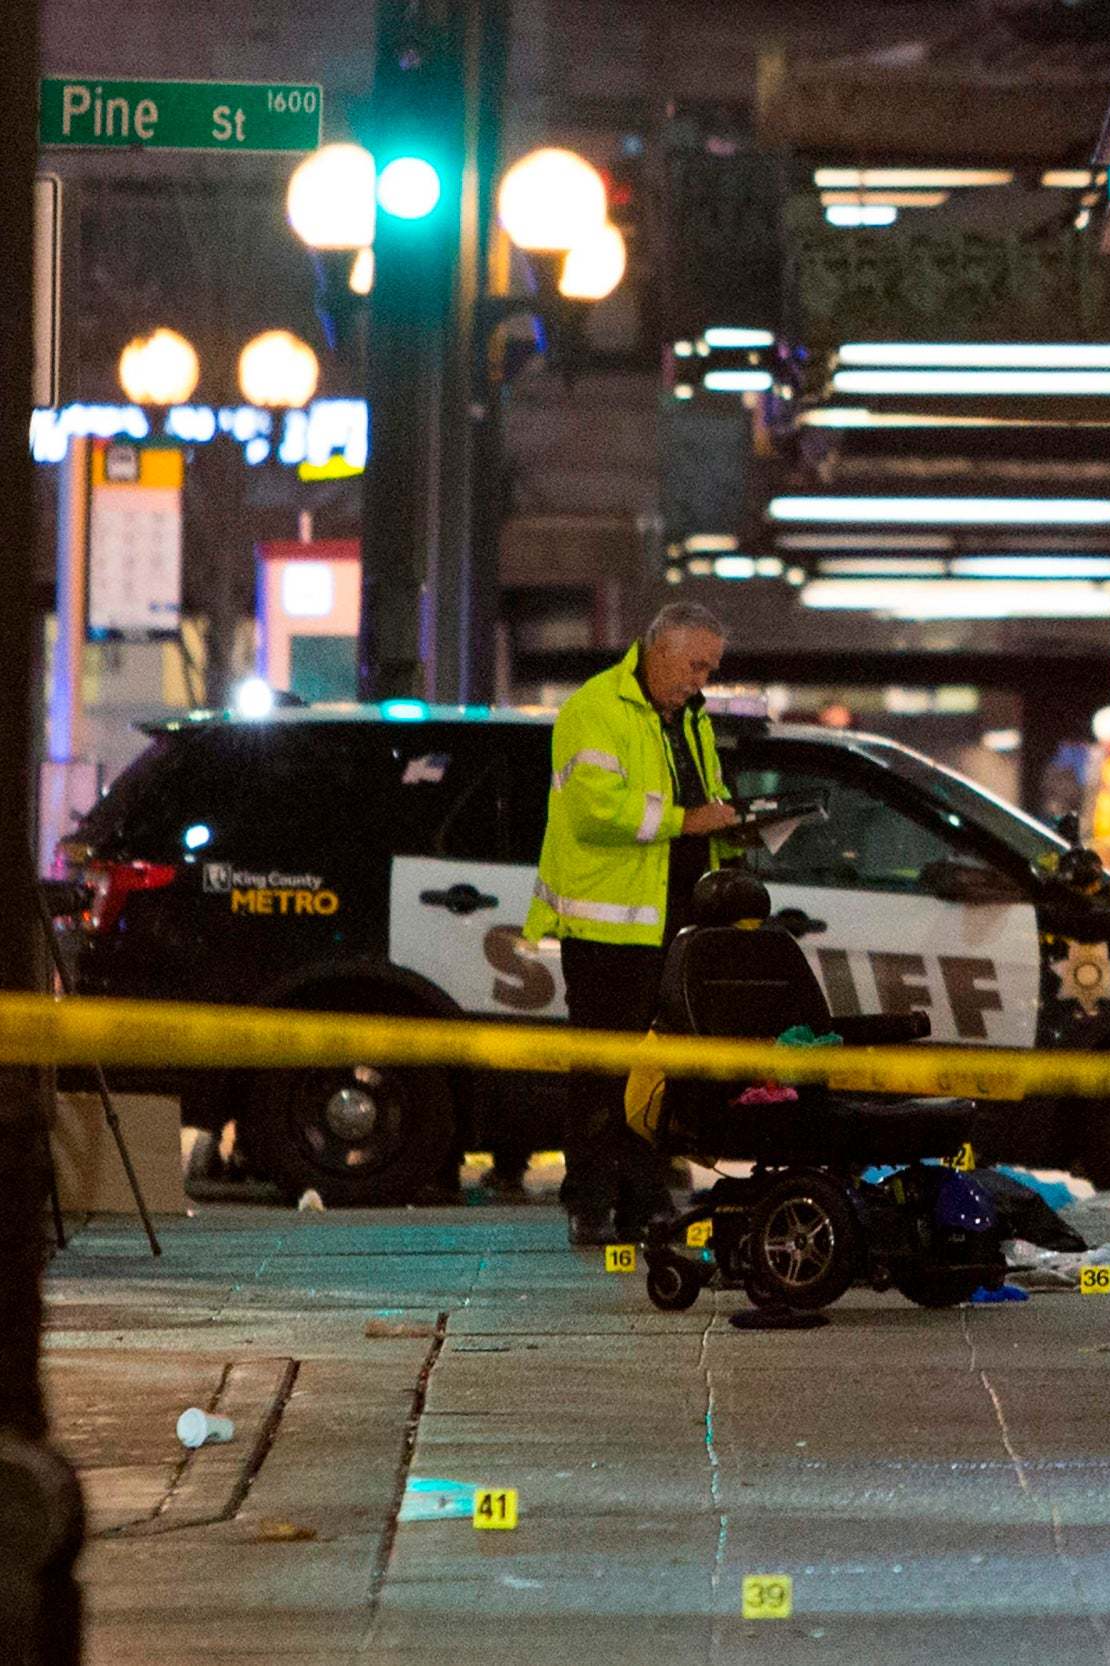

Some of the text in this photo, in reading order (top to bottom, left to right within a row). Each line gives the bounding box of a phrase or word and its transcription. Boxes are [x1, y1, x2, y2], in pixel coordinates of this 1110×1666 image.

[62, 84, 246, 141] Pine St
[267, 89, 317, 113] 1600
[232, 871, 322, 890] King County
[231, 888, 339, 916] METRO
[612, 1249, 632, 1267] 16
[1083, 1268, 1110, 1288] 36
[480, 1493, 506, 1519] 41
[746, 1582, 785, 1608] 39
